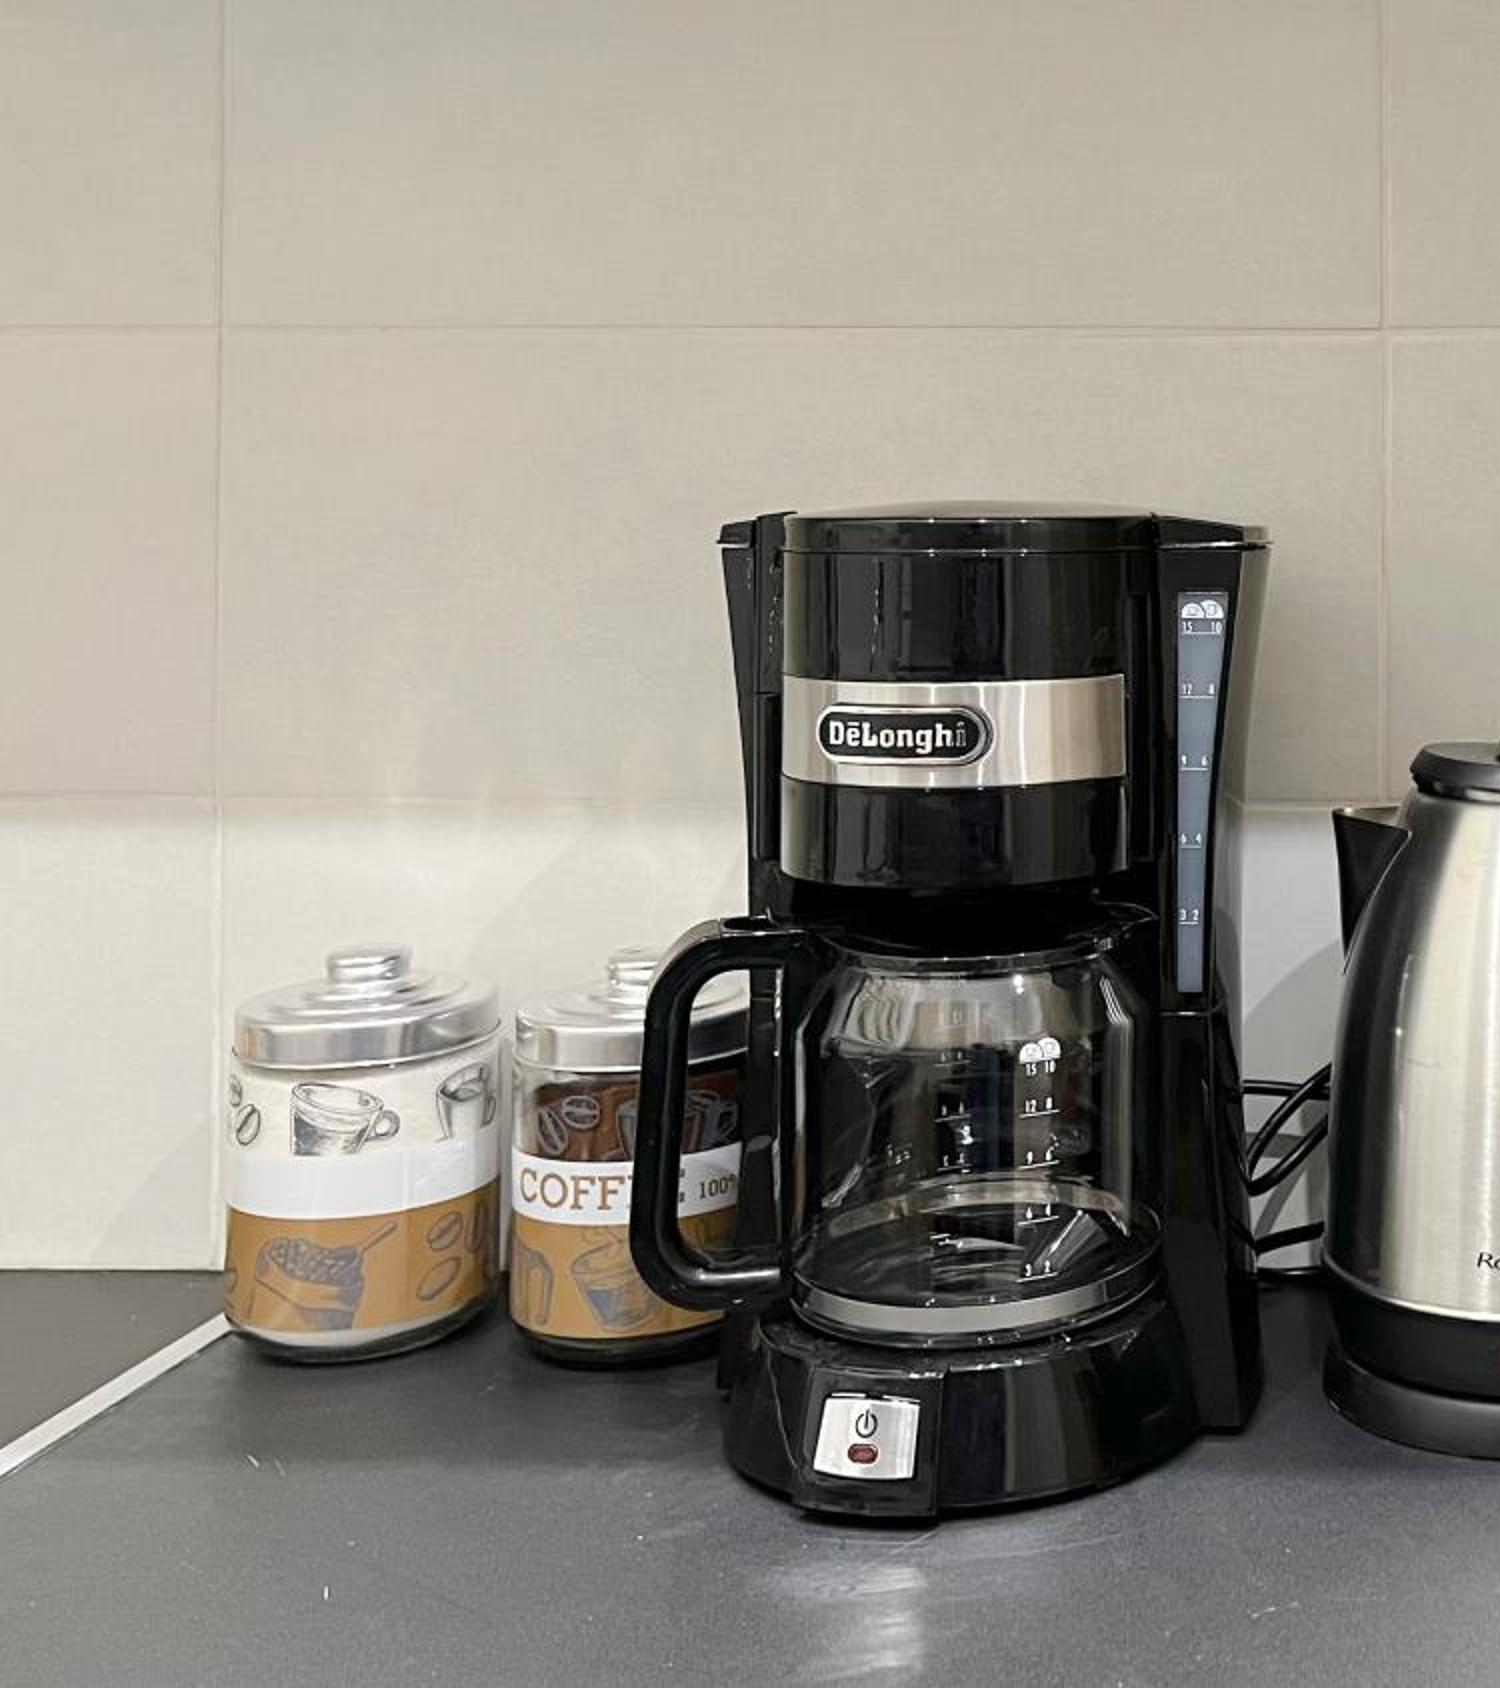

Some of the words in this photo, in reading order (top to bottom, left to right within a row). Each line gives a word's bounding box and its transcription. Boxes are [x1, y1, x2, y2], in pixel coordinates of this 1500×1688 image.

[1183, 621, 1193, 633] 15
[1211, 621, 1223, 634] 10
[1180, 909, 1187, 921] 3
[1192, 909, 1199, 921] 2
[1025, 1063, 1037, 1077] 15
[519, 1167, 686, 1211] COFF
